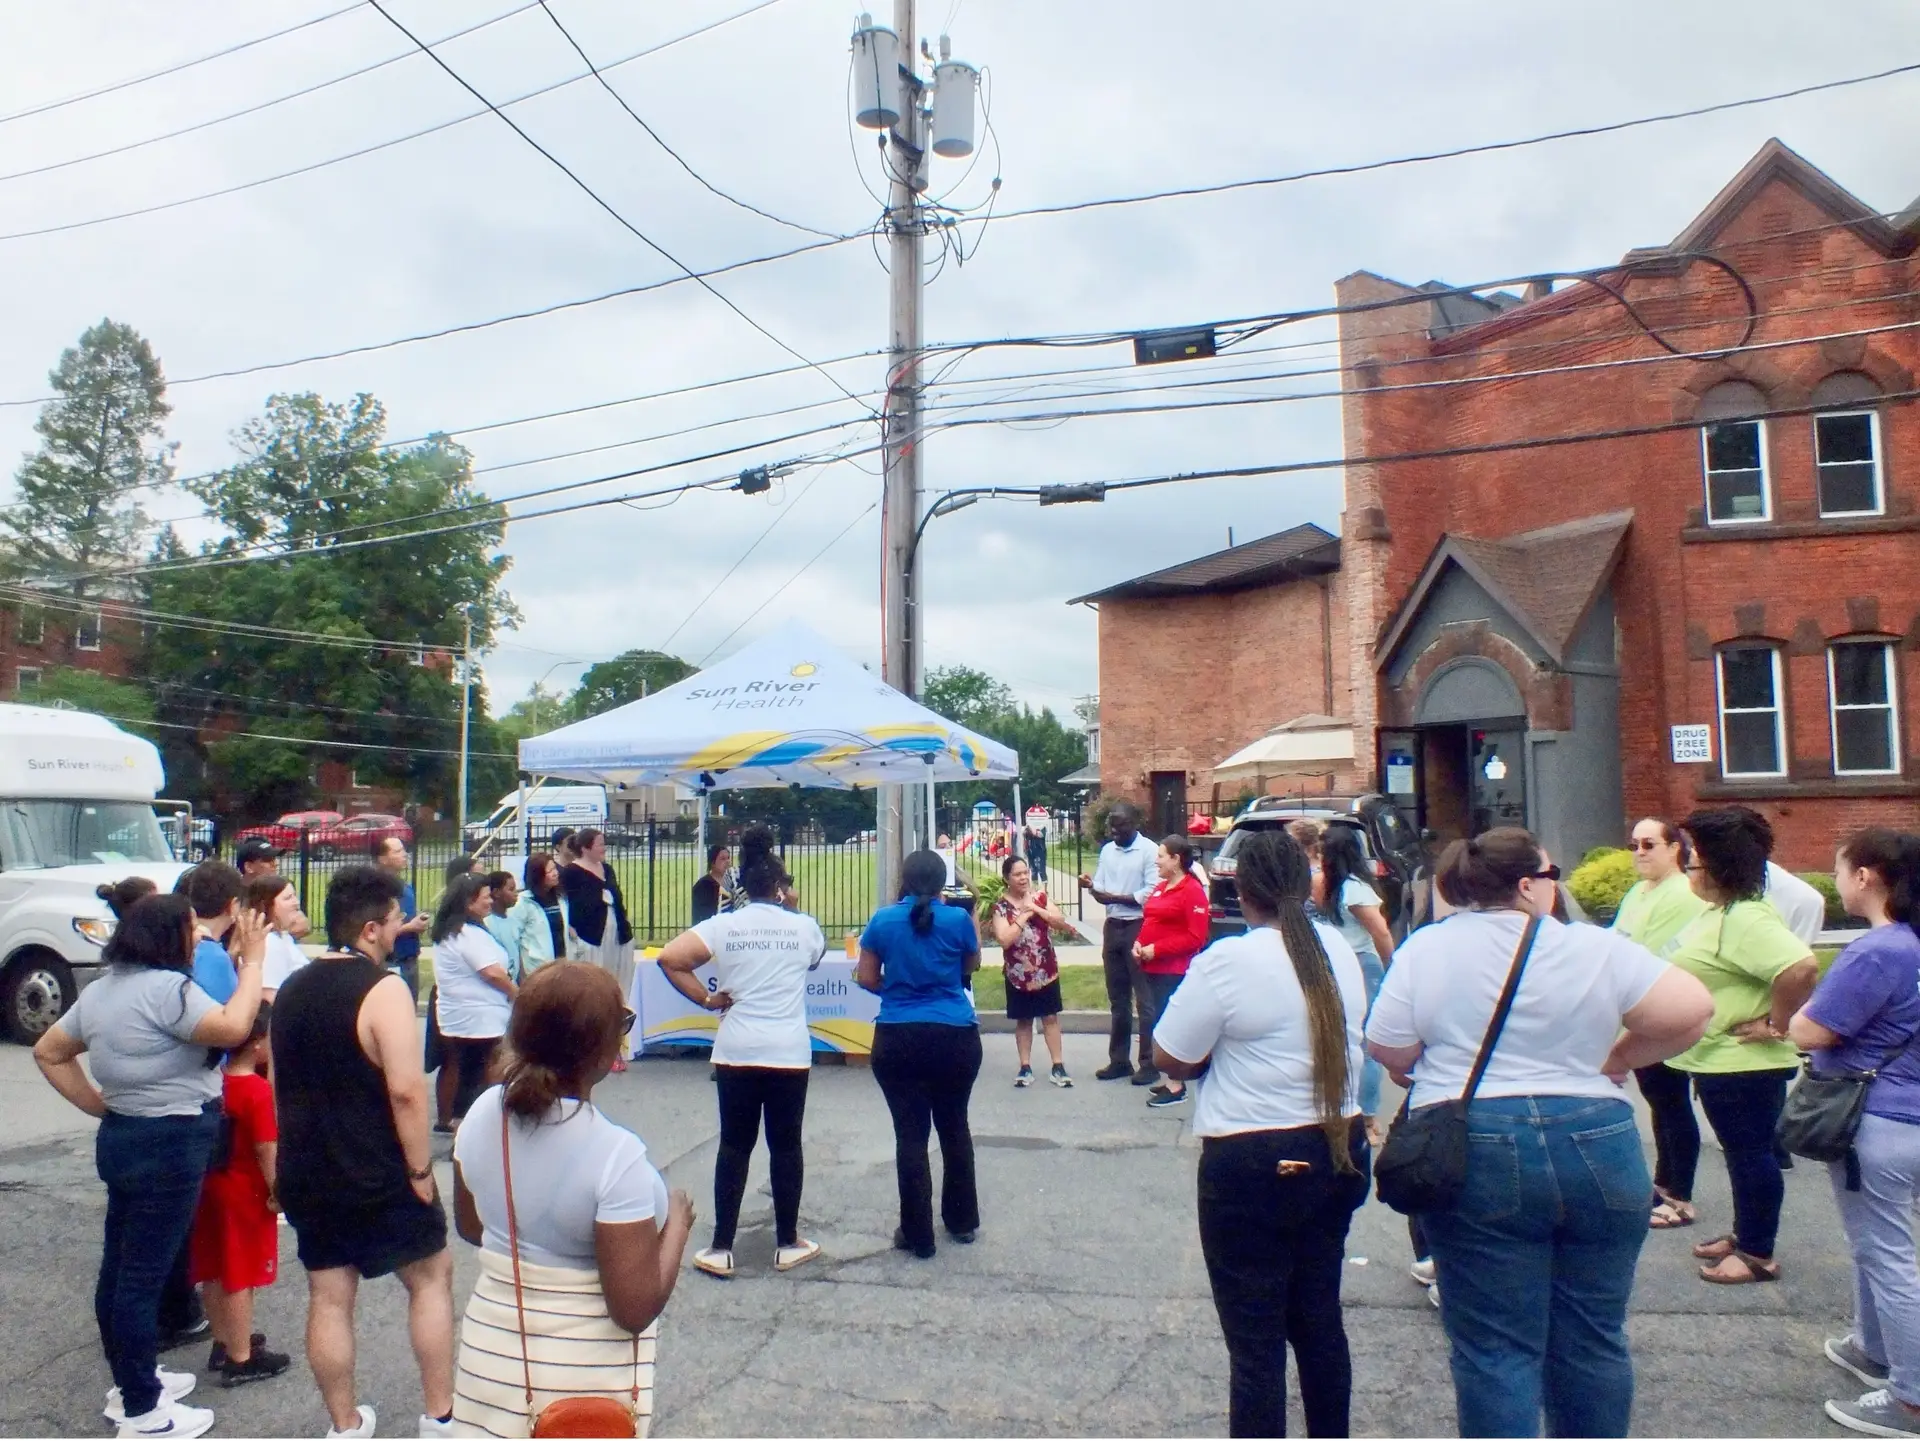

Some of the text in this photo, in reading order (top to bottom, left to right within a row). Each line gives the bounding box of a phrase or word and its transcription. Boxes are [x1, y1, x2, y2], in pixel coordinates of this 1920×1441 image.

[686, 680, 820, 700] Sun River
[712, 696, 804, 711] Health
[1675, 729, 1707, 738] DRUG
[1677, 739, 1707, 748] FREE
[1676, 749, 1708, 758] ZONE
[28, 759, 55, 770] Sun
[58, 759, 90, 770] River
[725, 940, 799, 952] RESPONSE TEAM
[806, 979, 848, 996] ealth
